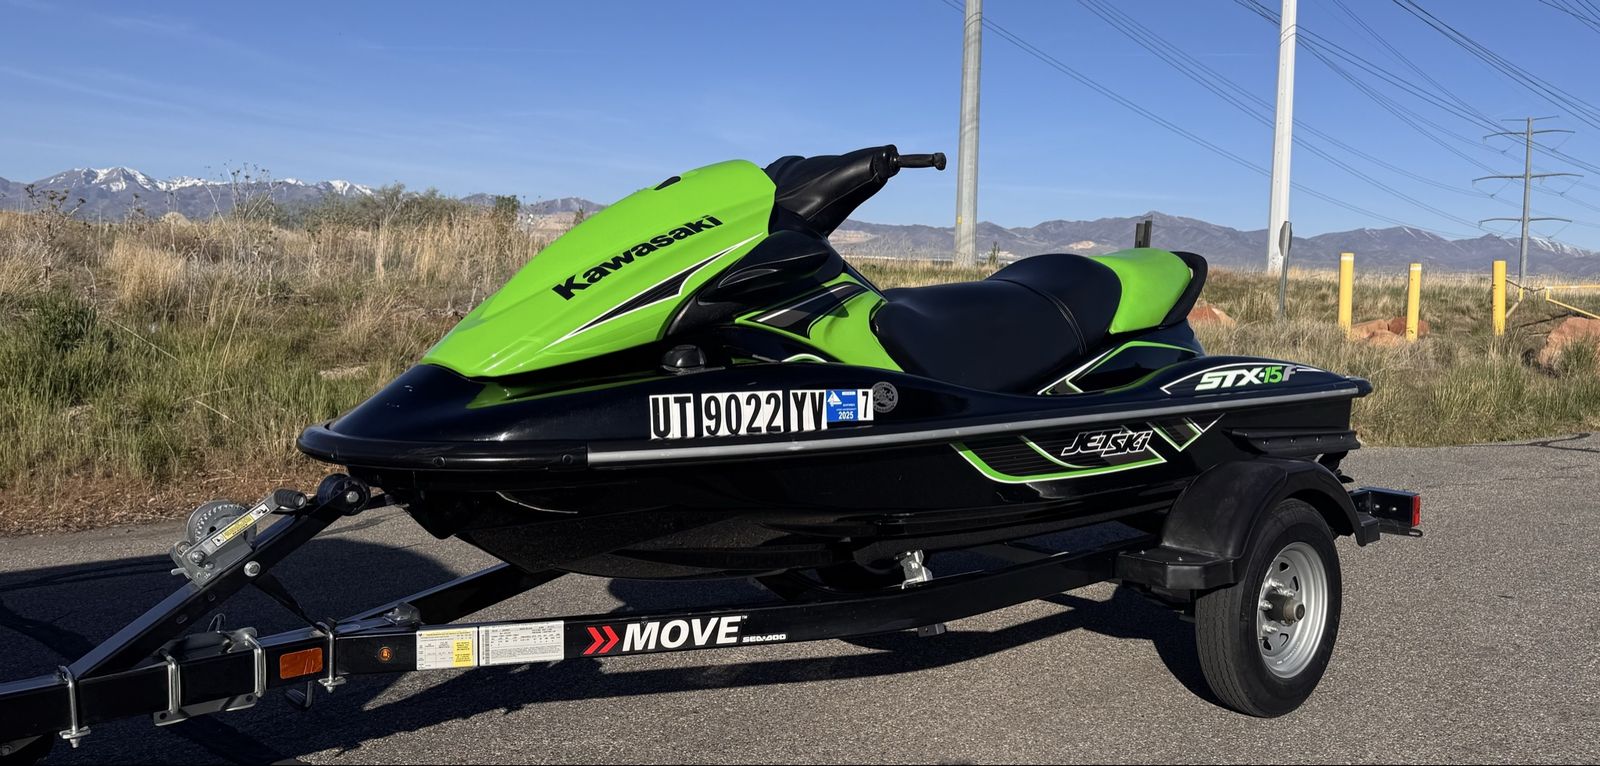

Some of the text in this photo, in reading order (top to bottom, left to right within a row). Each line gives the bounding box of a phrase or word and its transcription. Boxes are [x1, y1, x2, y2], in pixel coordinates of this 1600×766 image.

[552, 215, 723, 300] Kawasaki
[1195, 366, 1296, 391] STX-15F
[651, 396, 692, 438] UT
[704, 393, 782, 436] 9022
[792, 391, 825, 432] YV
[862, 391, 869, 418] 7
[838, 411, 854, 420] 2025
[622, 616, 741, 652] MOVE
